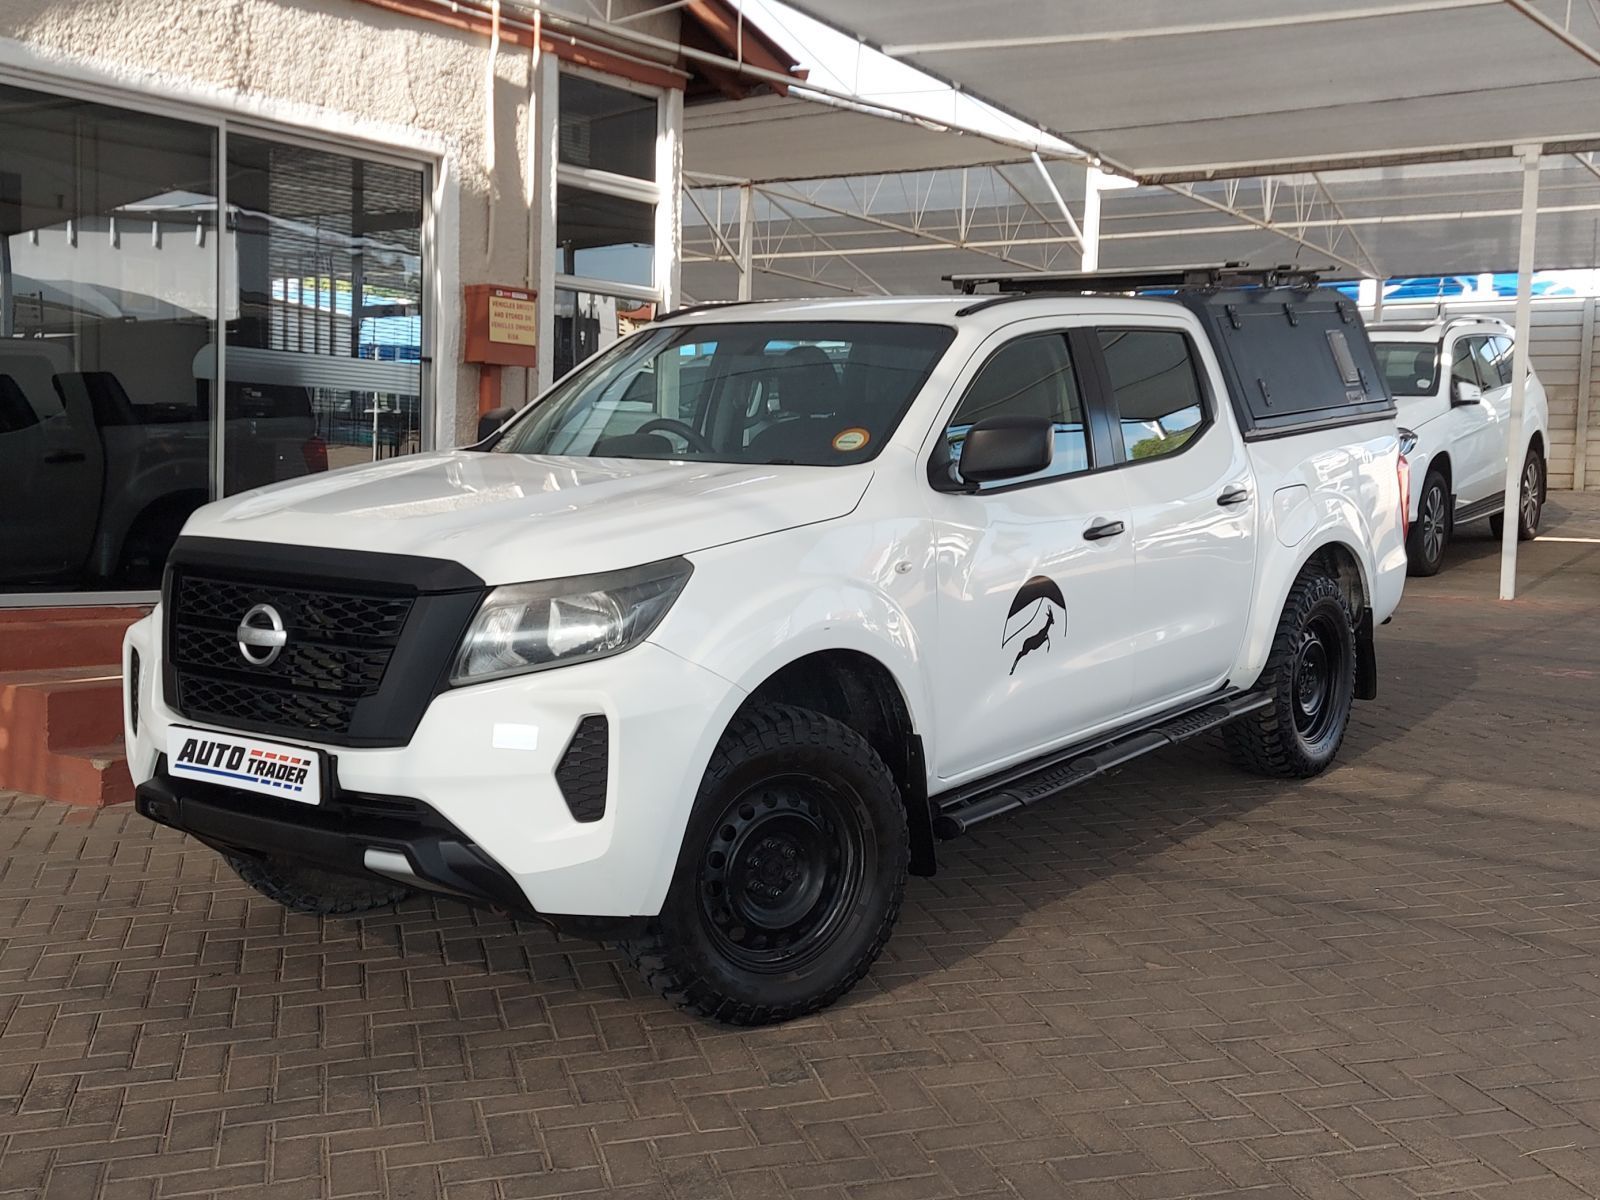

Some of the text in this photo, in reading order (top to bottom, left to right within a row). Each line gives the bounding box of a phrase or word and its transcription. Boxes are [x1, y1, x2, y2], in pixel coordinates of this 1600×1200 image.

[492, 301, 515, 309] VEHICLES
[177, 738, 308, 785] AUTO TRADER
